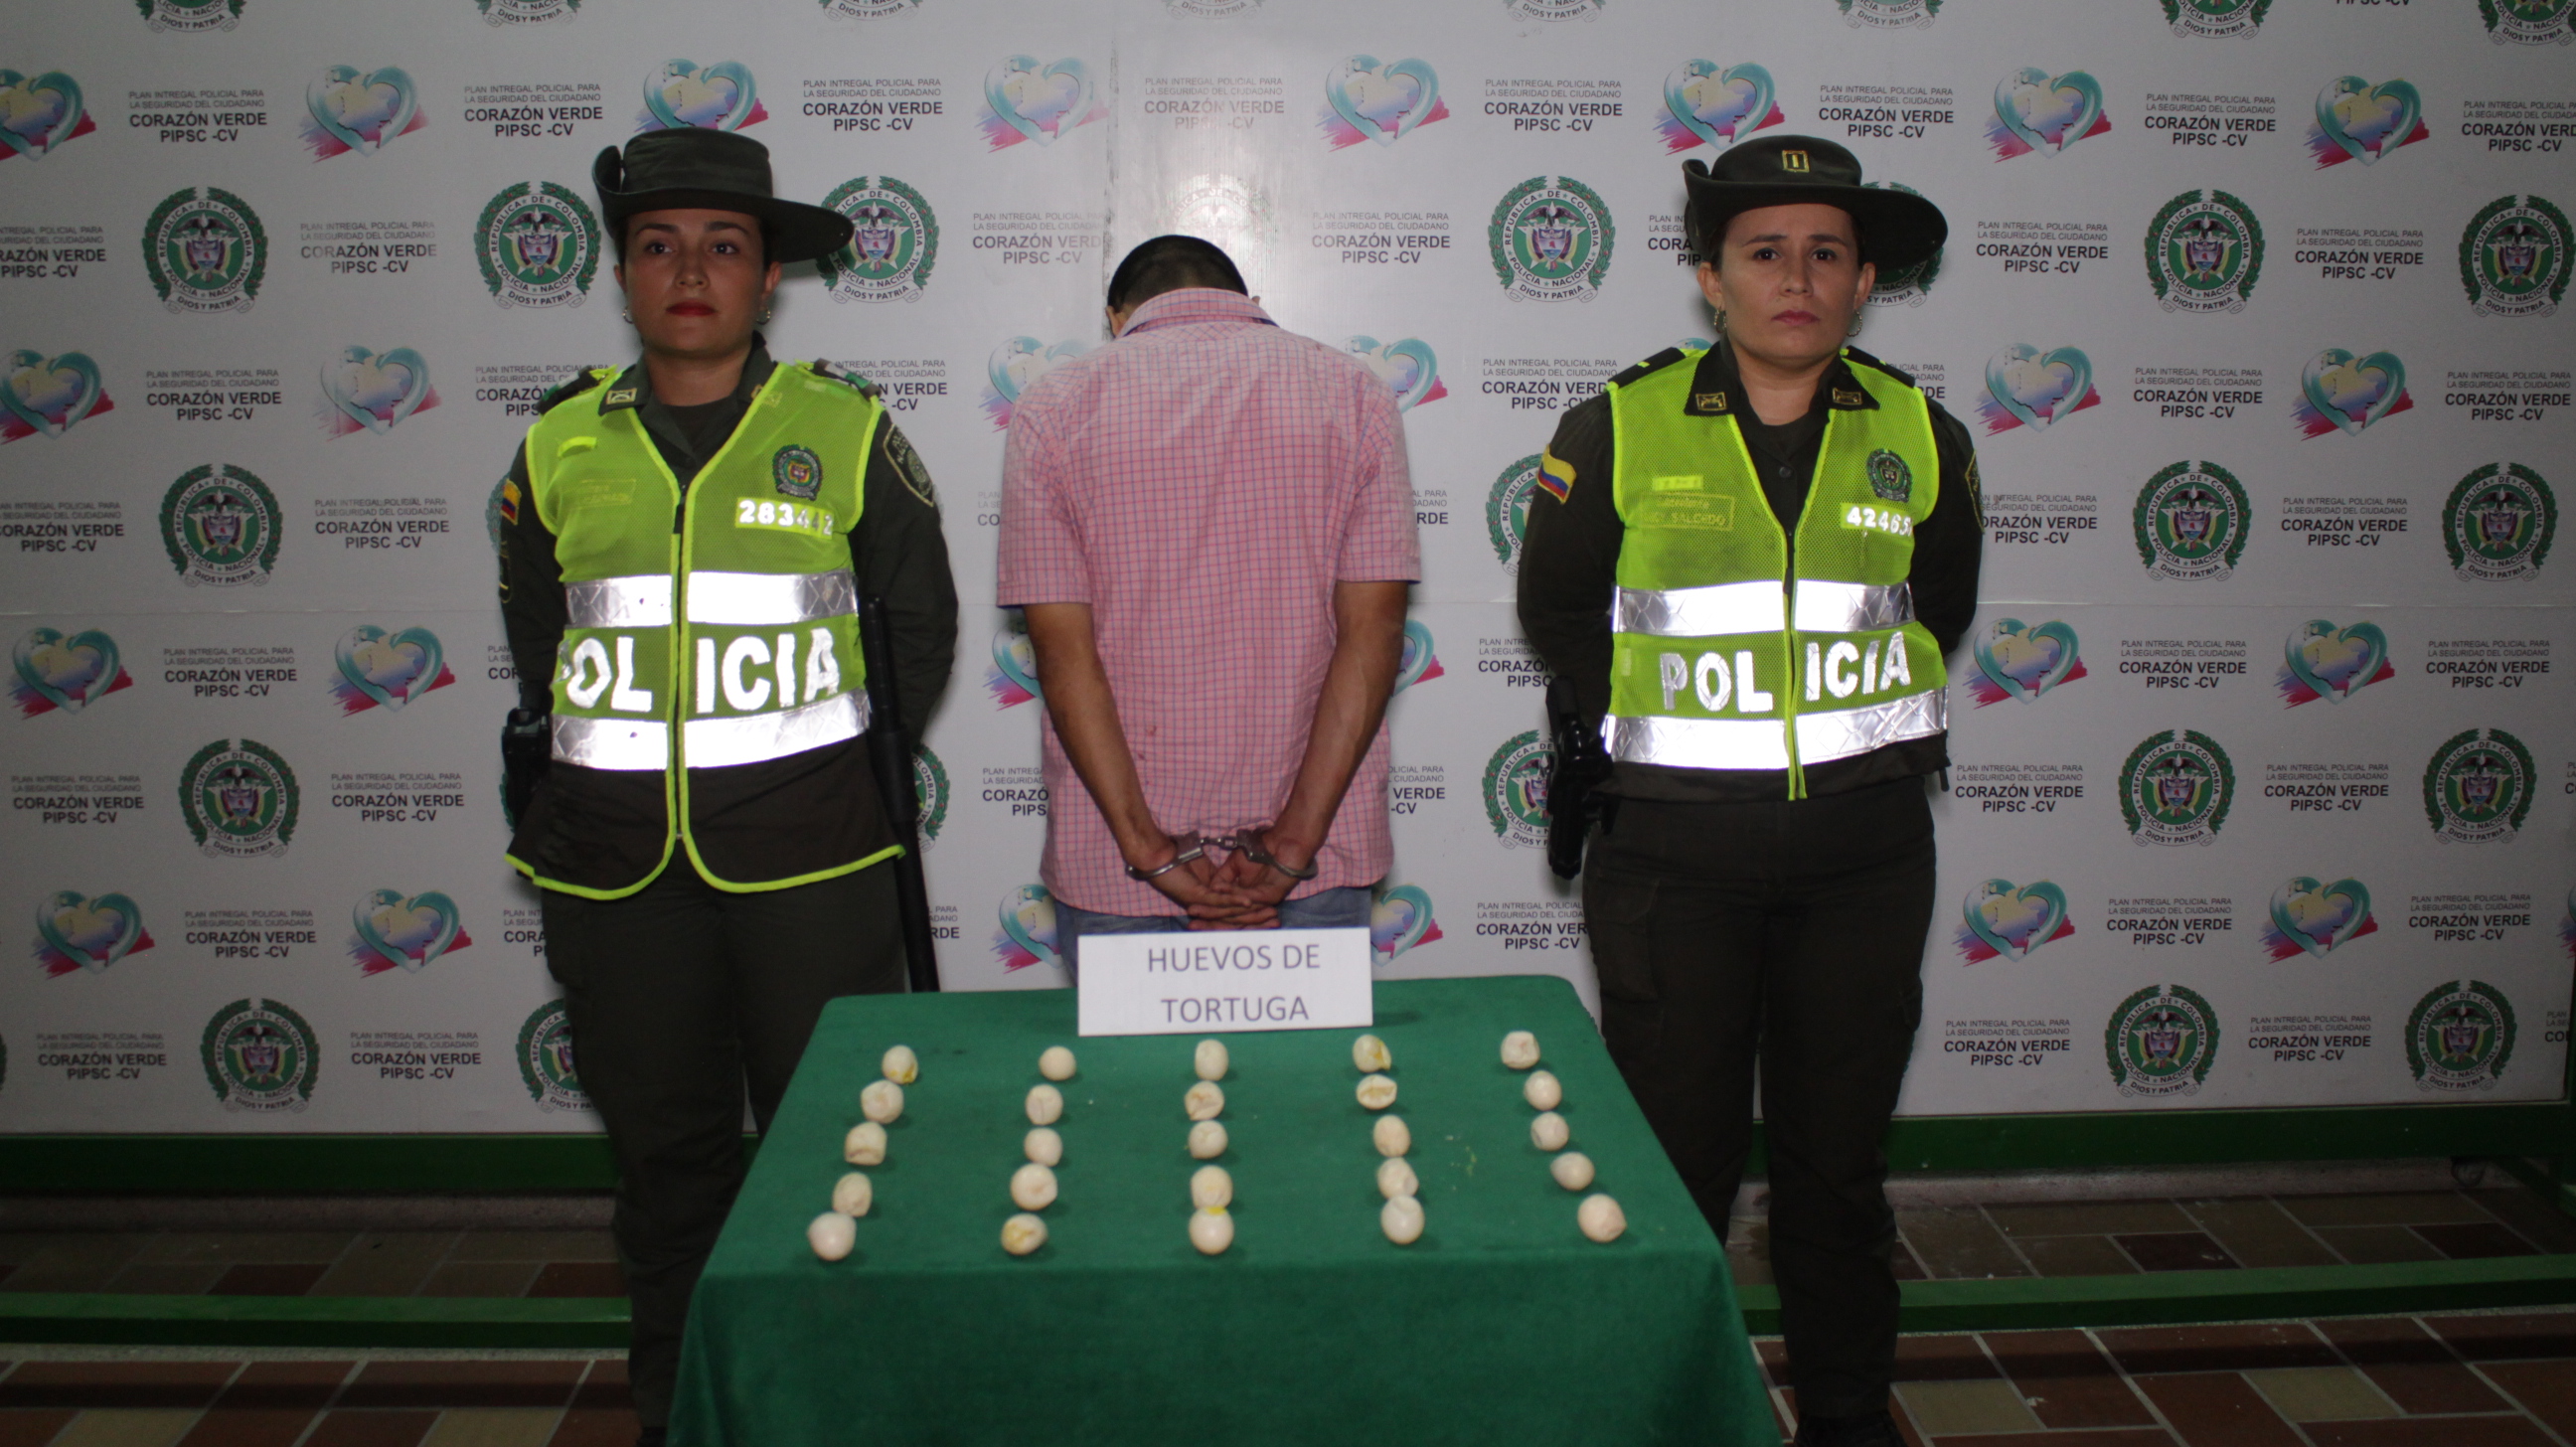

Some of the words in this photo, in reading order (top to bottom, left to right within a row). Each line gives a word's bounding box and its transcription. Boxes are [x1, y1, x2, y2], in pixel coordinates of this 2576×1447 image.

[803, 80, 827, 88] PLAN
[829, 79, 873, 87] INTREGAL
[876, 79, 914, 87] POLICIAL
[917, 78, 941, 86] PARA
[1485, 79, 1509, 87] PLAN
[1511, 79, 1553, 87] INTREGAL
[1556, 80, 1595, 88] POLICIAL
[1598, 80, 1622, 88] PARA
[803, 89, 815, 98] LA
[816, 88, 869, 98] SEGURIDAD
[870, 88, 886, 97] DEL
[888, 87, 942, 97] CIUDADANO
[1485, 88, 1497, 97] LA
[1498, 88, 1549, 97] SEGURIDAD
[1550, 89, 1567, 98] DEL
[1569, 89, 1622, 98] CIUDADANO
[464, 105, 545, 121] CORAZÓN
[549, 106, 603, 120] VERDE
[803, 100, 884, 115] CORAZÓN
[888, 101, 943, 114] VERDE
[1485, 100, 1564, 115] CORAZÓN
[1568, 103, 1623, 116] VERDE
[129, 111, 209, 127] CORAZÓN
[213, 112, 267, 126] VERDE
[833, 118, 881, 131] PIPSC
[1514, 118, 1561, 131] PIPSC
[2145, 114, 2221, 130] CORAZÓN
[2225, 118, 2276, 132] VERDE
[159, 129, 207, 142] PIPSC
[494, 123, 542, 136] PIPSC
[2173, 132, 2217, 145] PIPSC
[1571, 197, 1599, 246] COLOMBIA
[2224, 210, 2248, 259] COLOMBIA
[1396, 236, 1451, 248] VERDE
[1976, 241, 2053, 257] CORAZÓN
[2057, 245, 2109, 258] VERDE
[2295, 248, 2369, 263] CORAZÓN
[2373, 251, 2424, 264] VERDE
[1342, 250, 1389, 263] PIPSC
[1551, 258, 1594, 286] NACIONAL
[2004, 259, 2049, 272] PIPSC
[2322, 266, 2366, 278] PIPSC
[2203, 269, 2245, 297] NACIONAL
[1551, 285, 1584, 299] PATRIA
[2202, 296, 2233, 310] PATRIA
[146, 391, 225, 405] CORAZÓN
[229, 392, 282, 404] VERDE
[2133, 388, 2208, 402] CORAZÓN
[2212, 391, 2263, 403] VERDE
[2445, 392, 2518, 405] CORAZÓN
[2522, 394, 2571, 405] VERDE
[176, 407, 223, 420] PIPSC
[2161, 405, 2205, 417] PIPSC
[2471, 408, 2514, 420] PIPSC
[738, 499, 834, 537] 283442
[1847, 506, 1913, 537] 42465
[2281, 517, 2354, 531] CORAZÓN
[2358, 519, 2408, 531] VERDE
[315, 519, 394, 534] CORAZÓN
[397, 520, 449, 533] VERDE
[345, 537, 392, 549] PIPSC
[2308, 535, 2351, 546] PIPSC
[2119, 660, 2193, 674] CORAZÓN
[2197, 662, 2247, 674] VERDE
[2426, 659, 2498, 674] CORAZÓN
[2501, 661, 2550, 673] VERDE
[165, 668, 242, 683] CORAZÓN
[244, 669, 297, 682] VERDE
[2451, 676, 2495, 688] PIPSC
[2146, 677, 2190, 688] PIPSC
[193, 685, 240, 697] PIPSC
[1956, 784, 2029, 797] CORAZÓN
[2034, 786, 2083, 797] VERDE
[2264, 783, 2336, 797] CORAZÓN
[2340, 785, 2389, 797] VERDE
[332, 793, 408, 807] CORAZÓN
[412, 795, 464, 807] VERDE
[1982, 801, 2026, 812] PIPSC
[2290, 799, 2334, 811] PIPSC
[361, 810, 406, 821] PIPSC
[2107, 917, 2179, 931] CORAZÓN
[2183, 918, 2232, 930] VERDE
[2409, 913, 2480, 927] CORAZÓN
[2484, 914, 2531, 926] VERDE
[185, 929, 261, 944] CORAZÓN
[264, 931, 317, 943] VERDE
[2133, 933, 2176, 944] PIPSC
[2434, 929, 2477, 941] PIPSC
[215, 946, 260, 958] PIPSC
[1148, 945, 1272, 973] HUEVOS
[1283, 944, 1321, 969] DE
[1161, 996, 1309, 1023] TORTUGA
[1944, 1039, 2017, 1052] CORAZÓN
[2021, 1040, 2071, 1051] VERDE
[2248, 1034, 2320, 1048] CORAZÓN
[2324, 1036, 2371, 1047] VERDE
[351, 1051, 426, 1064] CORAZÓN
[430, 1053, 481, 1064] VERDE
[1970, 1054, 2013, 1065] PIPSC
[2274, 1049, 2317, 1061] PIPSC
[380, 1067, 425, 1078] PIPSC
